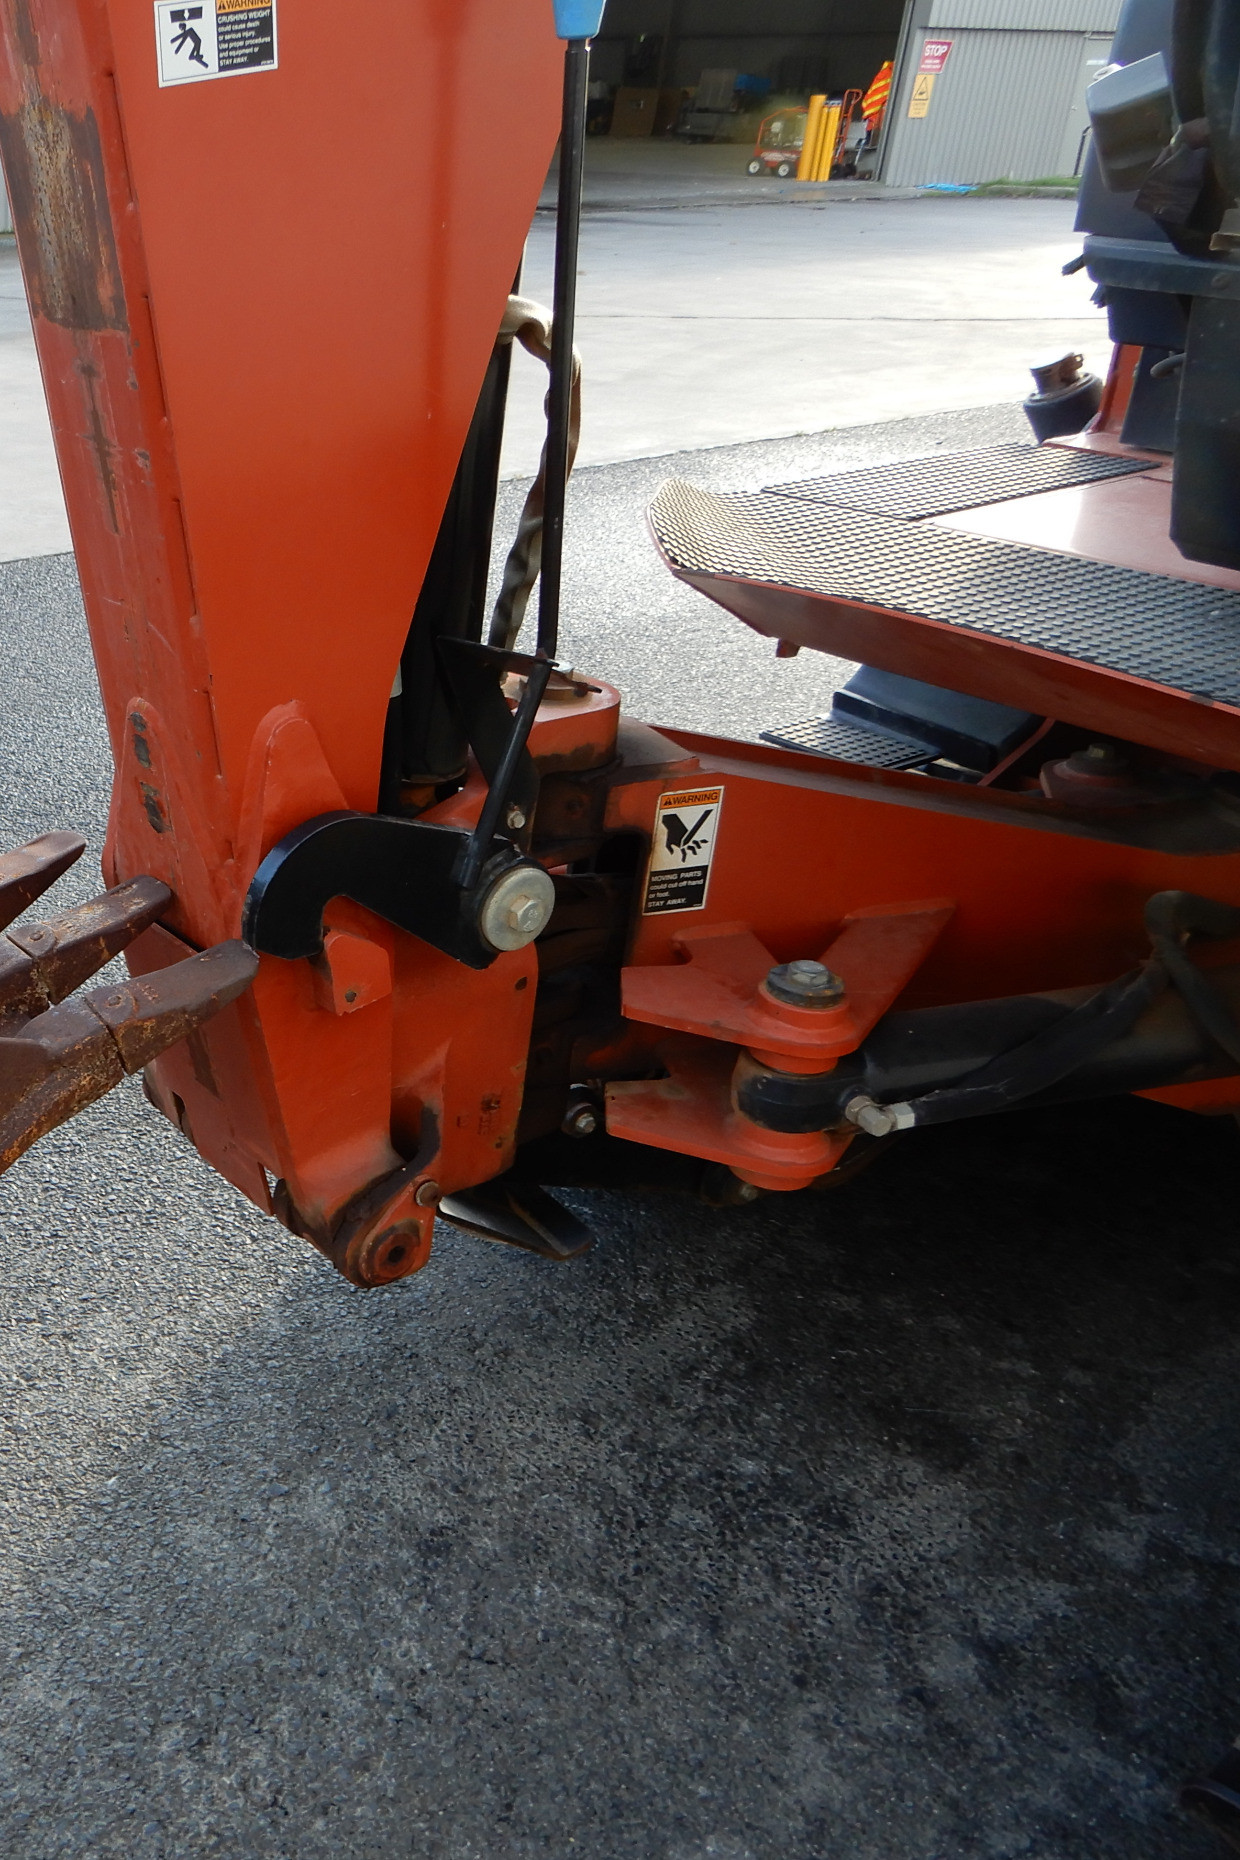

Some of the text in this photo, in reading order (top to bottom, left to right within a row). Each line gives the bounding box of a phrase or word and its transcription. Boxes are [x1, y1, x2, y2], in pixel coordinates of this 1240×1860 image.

[218, 9, 271, 24] CRUSHING WEIGHT
[218, 20, 260, 33] could cause death
[224, 32, 242, 40] serious
[229, 40, 245, 49] proper
[245, 36, 271, 47] procedures
[229, 47, 253, 56] equipment
[924, 45, 948, 57] STOP
[220, 58, 233, 67] STAY
[672, 792, 719, 804] WARNING
[651, 870, 702, 882] MOVING PARTS
